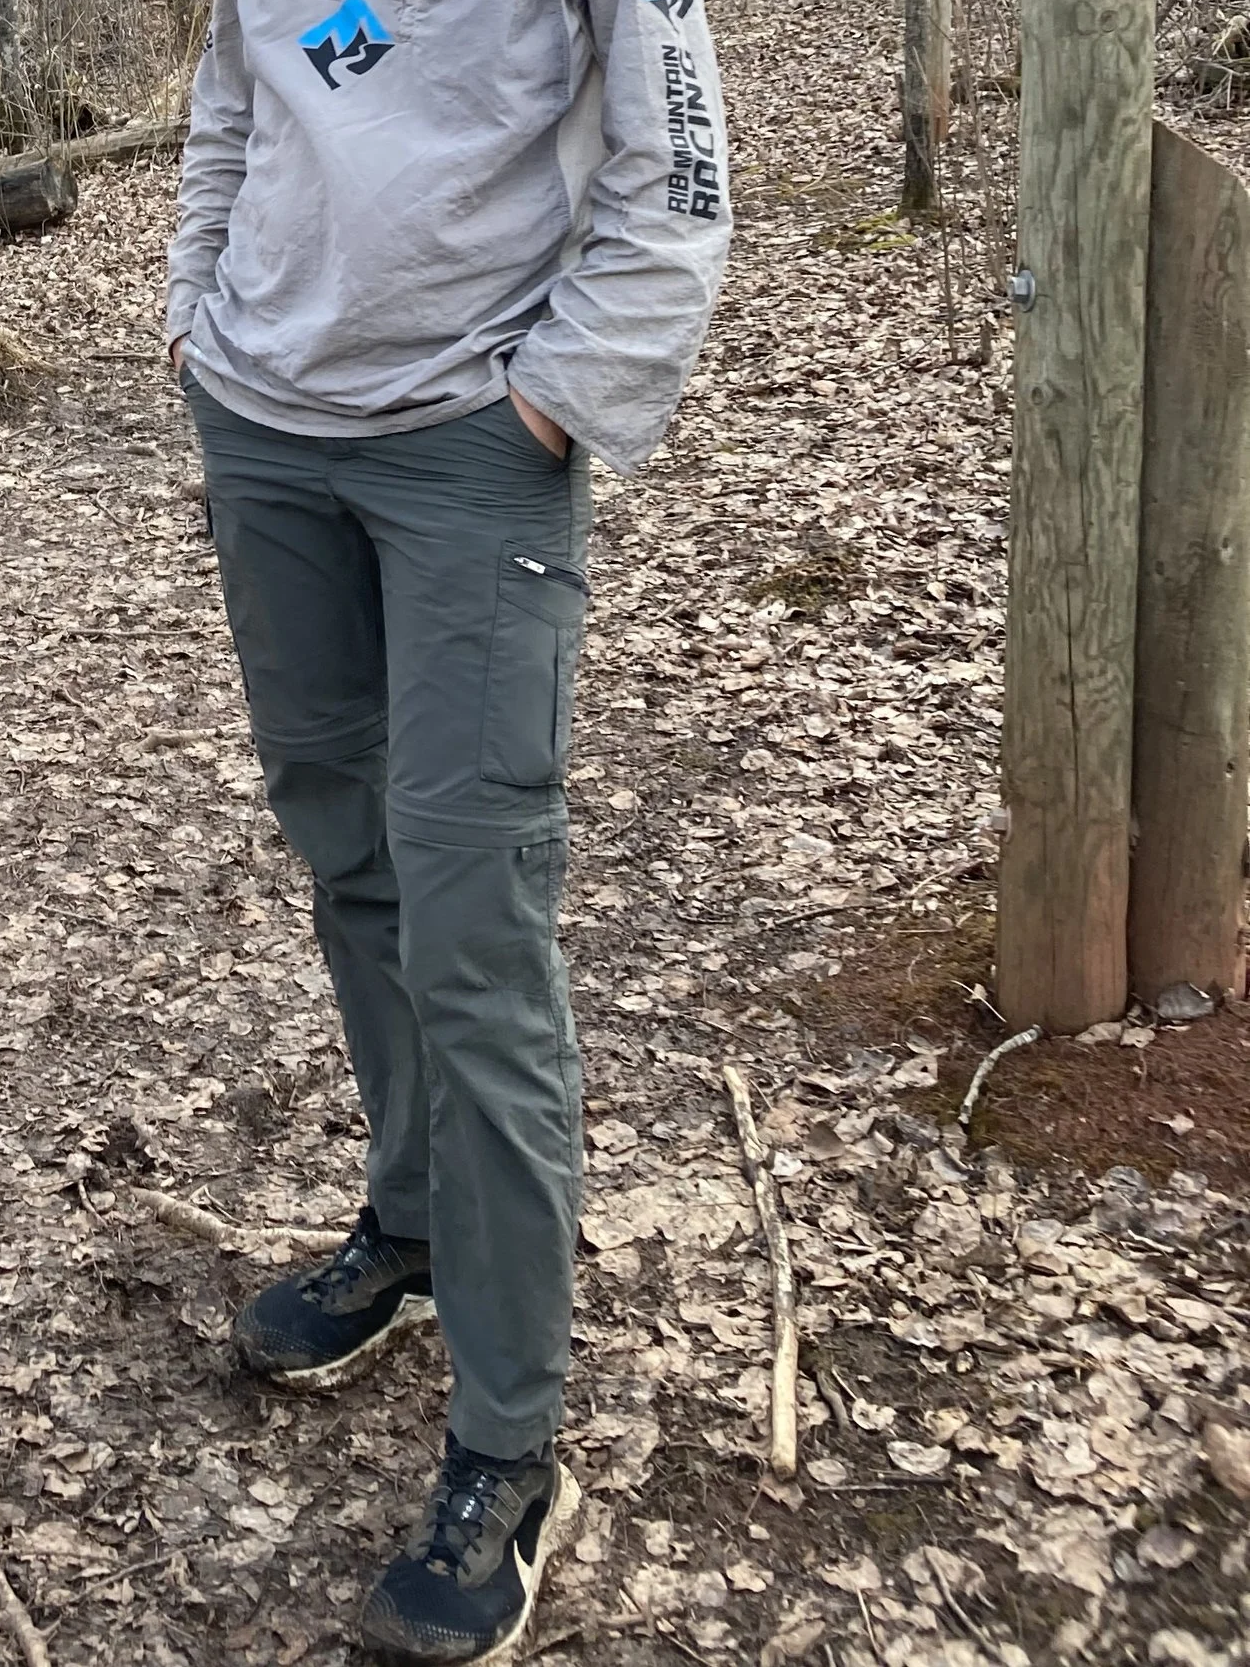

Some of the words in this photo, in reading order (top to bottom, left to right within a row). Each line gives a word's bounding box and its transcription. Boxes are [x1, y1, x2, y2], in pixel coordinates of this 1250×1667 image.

[661, 44, 693, 170] MOUNTAIN
[679, 48, 720, 221] RACING
[667, 172, 689, 215] RIB
